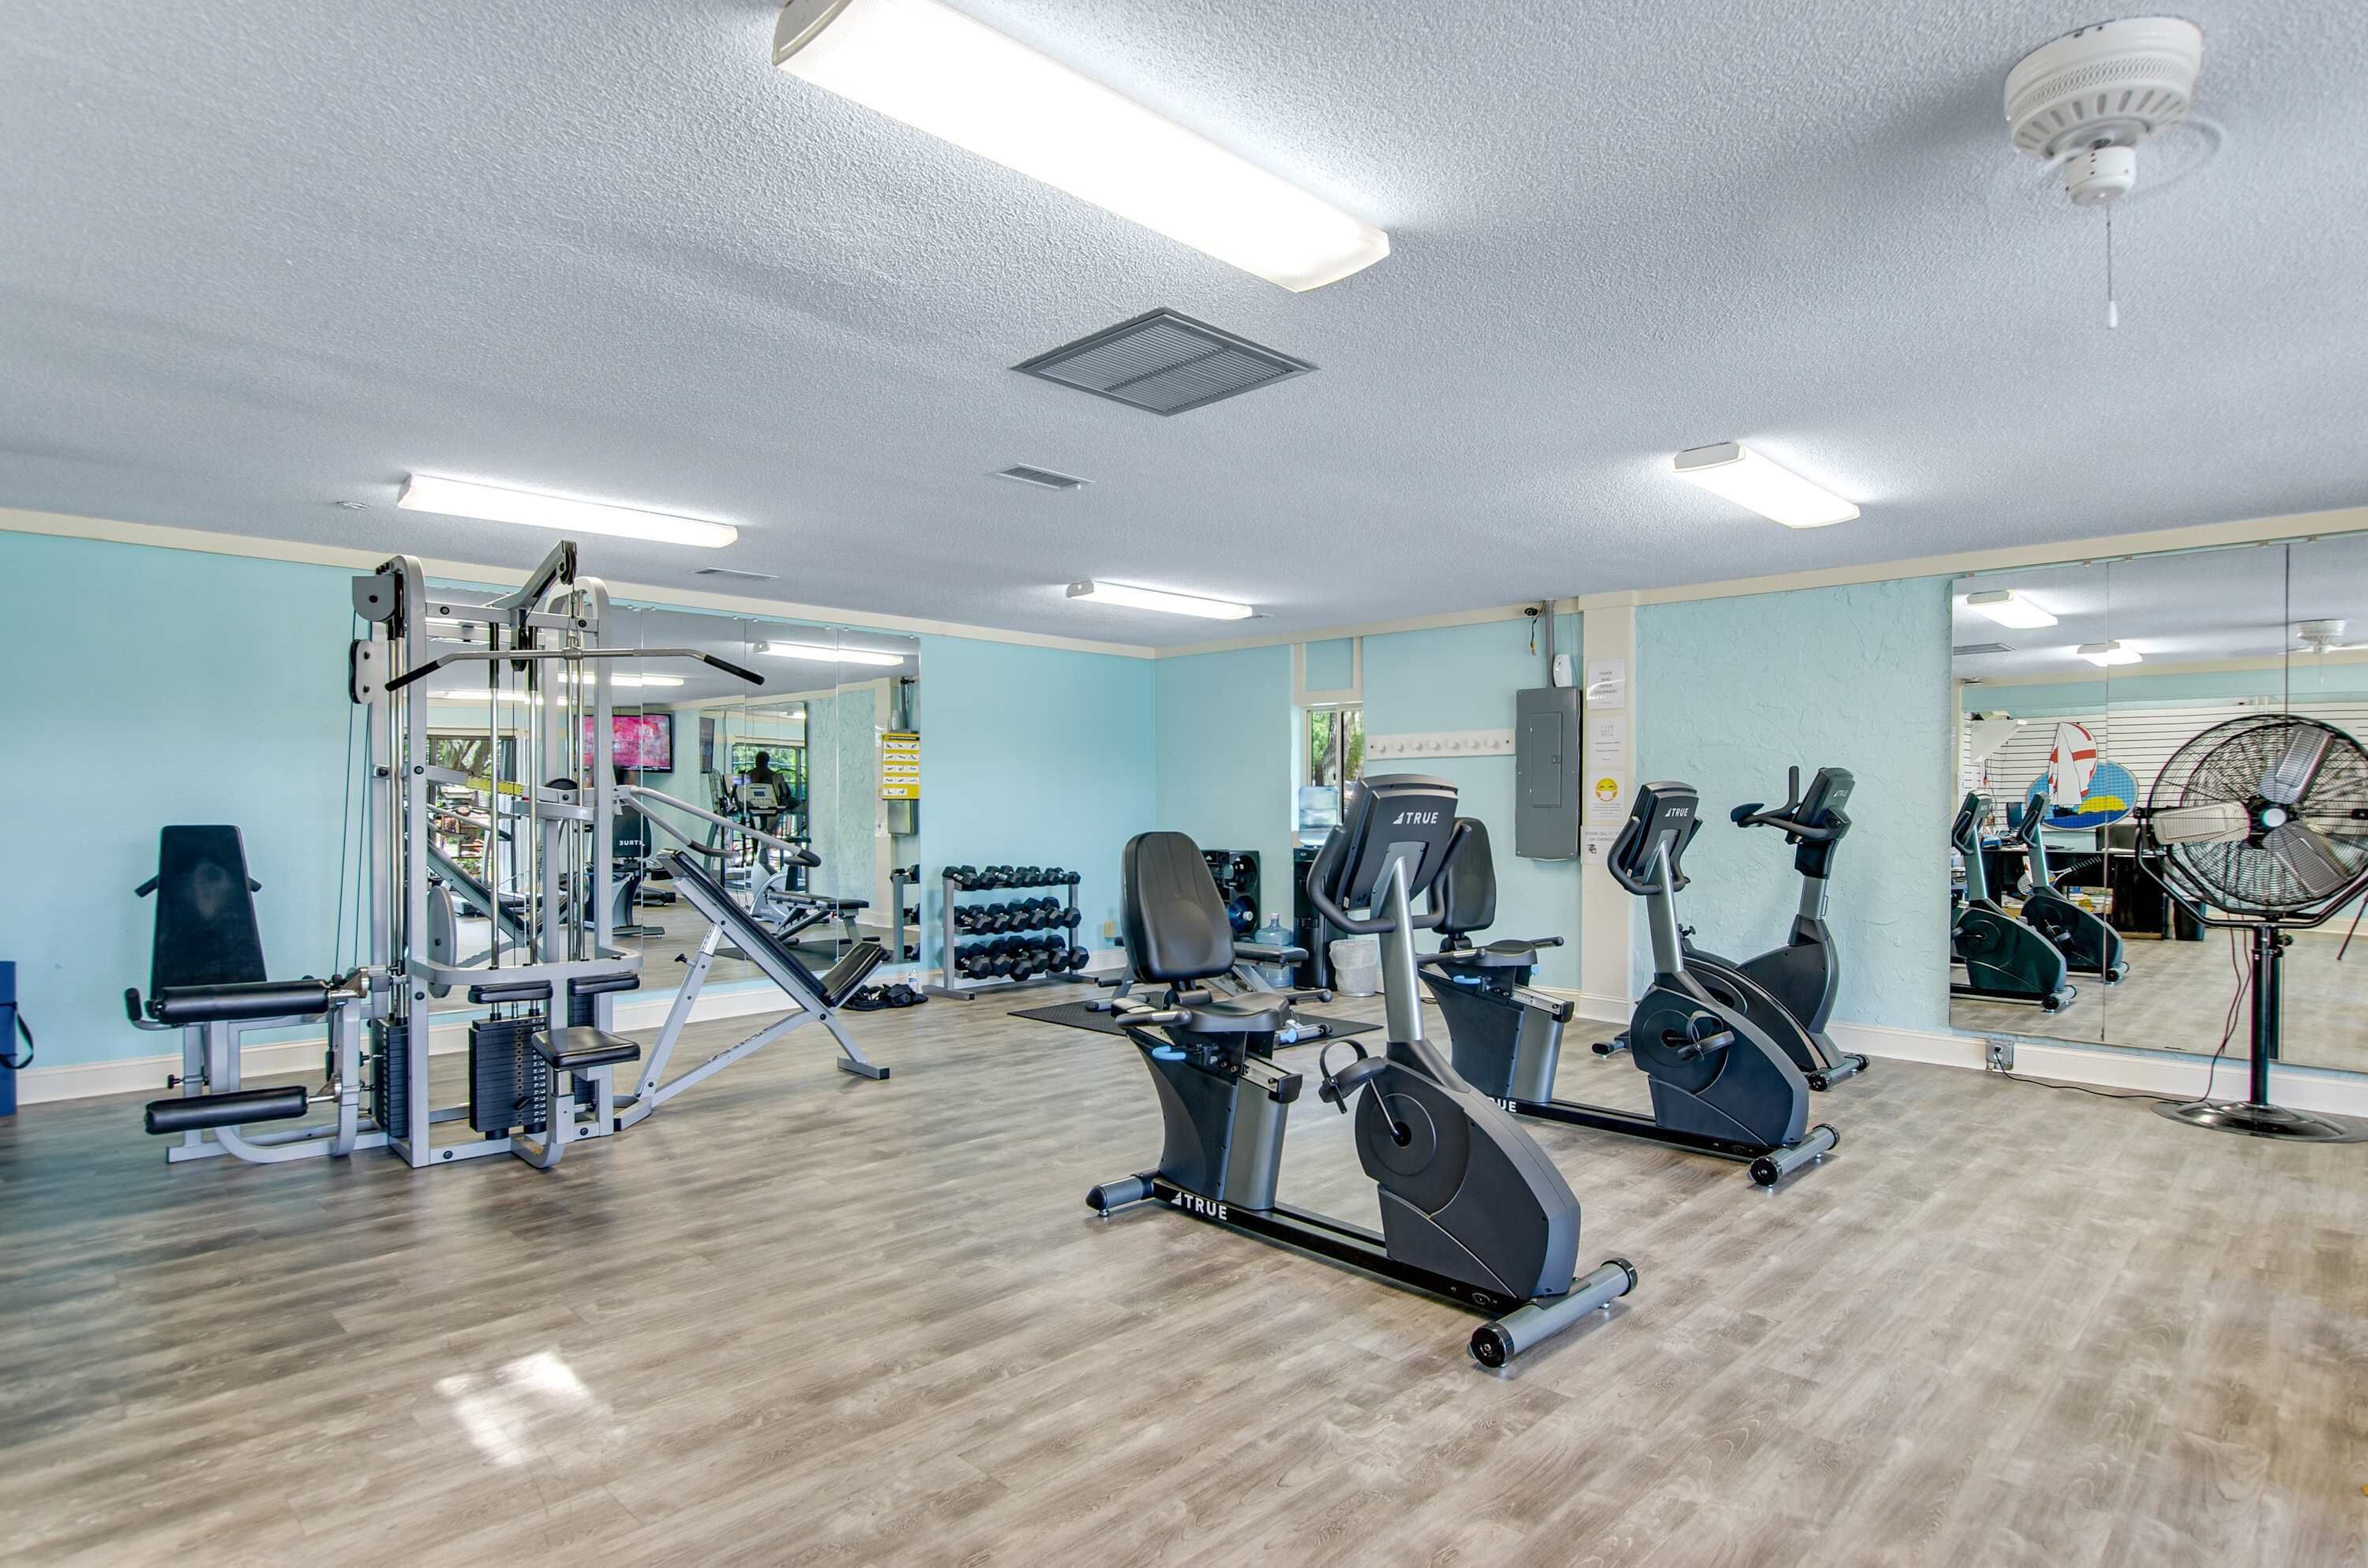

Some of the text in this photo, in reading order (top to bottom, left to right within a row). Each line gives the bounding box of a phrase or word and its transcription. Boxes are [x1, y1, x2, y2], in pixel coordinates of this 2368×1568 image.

[1406, 811, 1439, 825] TRUE
[1671, 807, 1689, 818] TRUE
[1488, 1096, 1516, 1113] UE
[1184, 1192, 1227, 1221] TRUE
